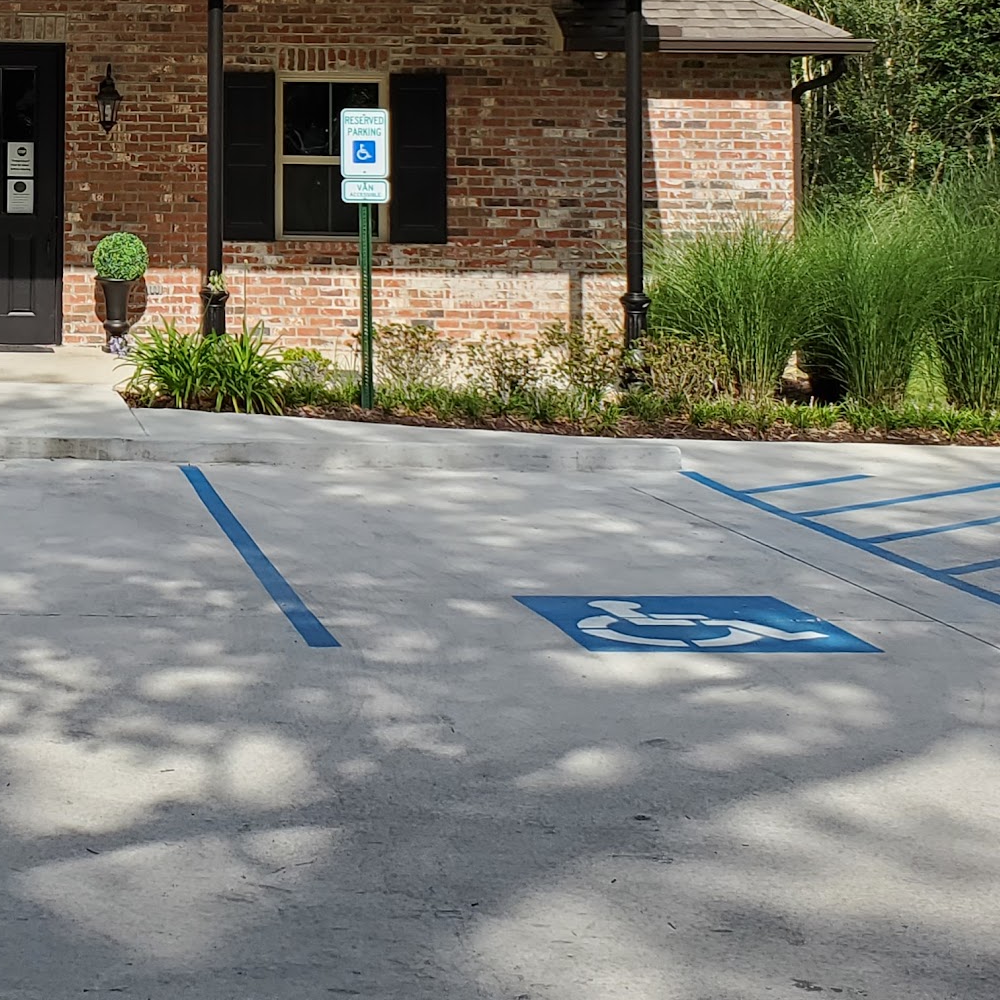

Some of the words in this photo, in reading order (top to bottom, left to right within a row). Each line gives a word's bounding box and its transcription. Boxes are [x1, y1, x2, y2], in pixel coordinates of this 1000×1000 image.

[344, 115, 384, 125] RESERVED
[347, 127, 382, 137] PARKING
[356, 183, 374, 191] VAN
